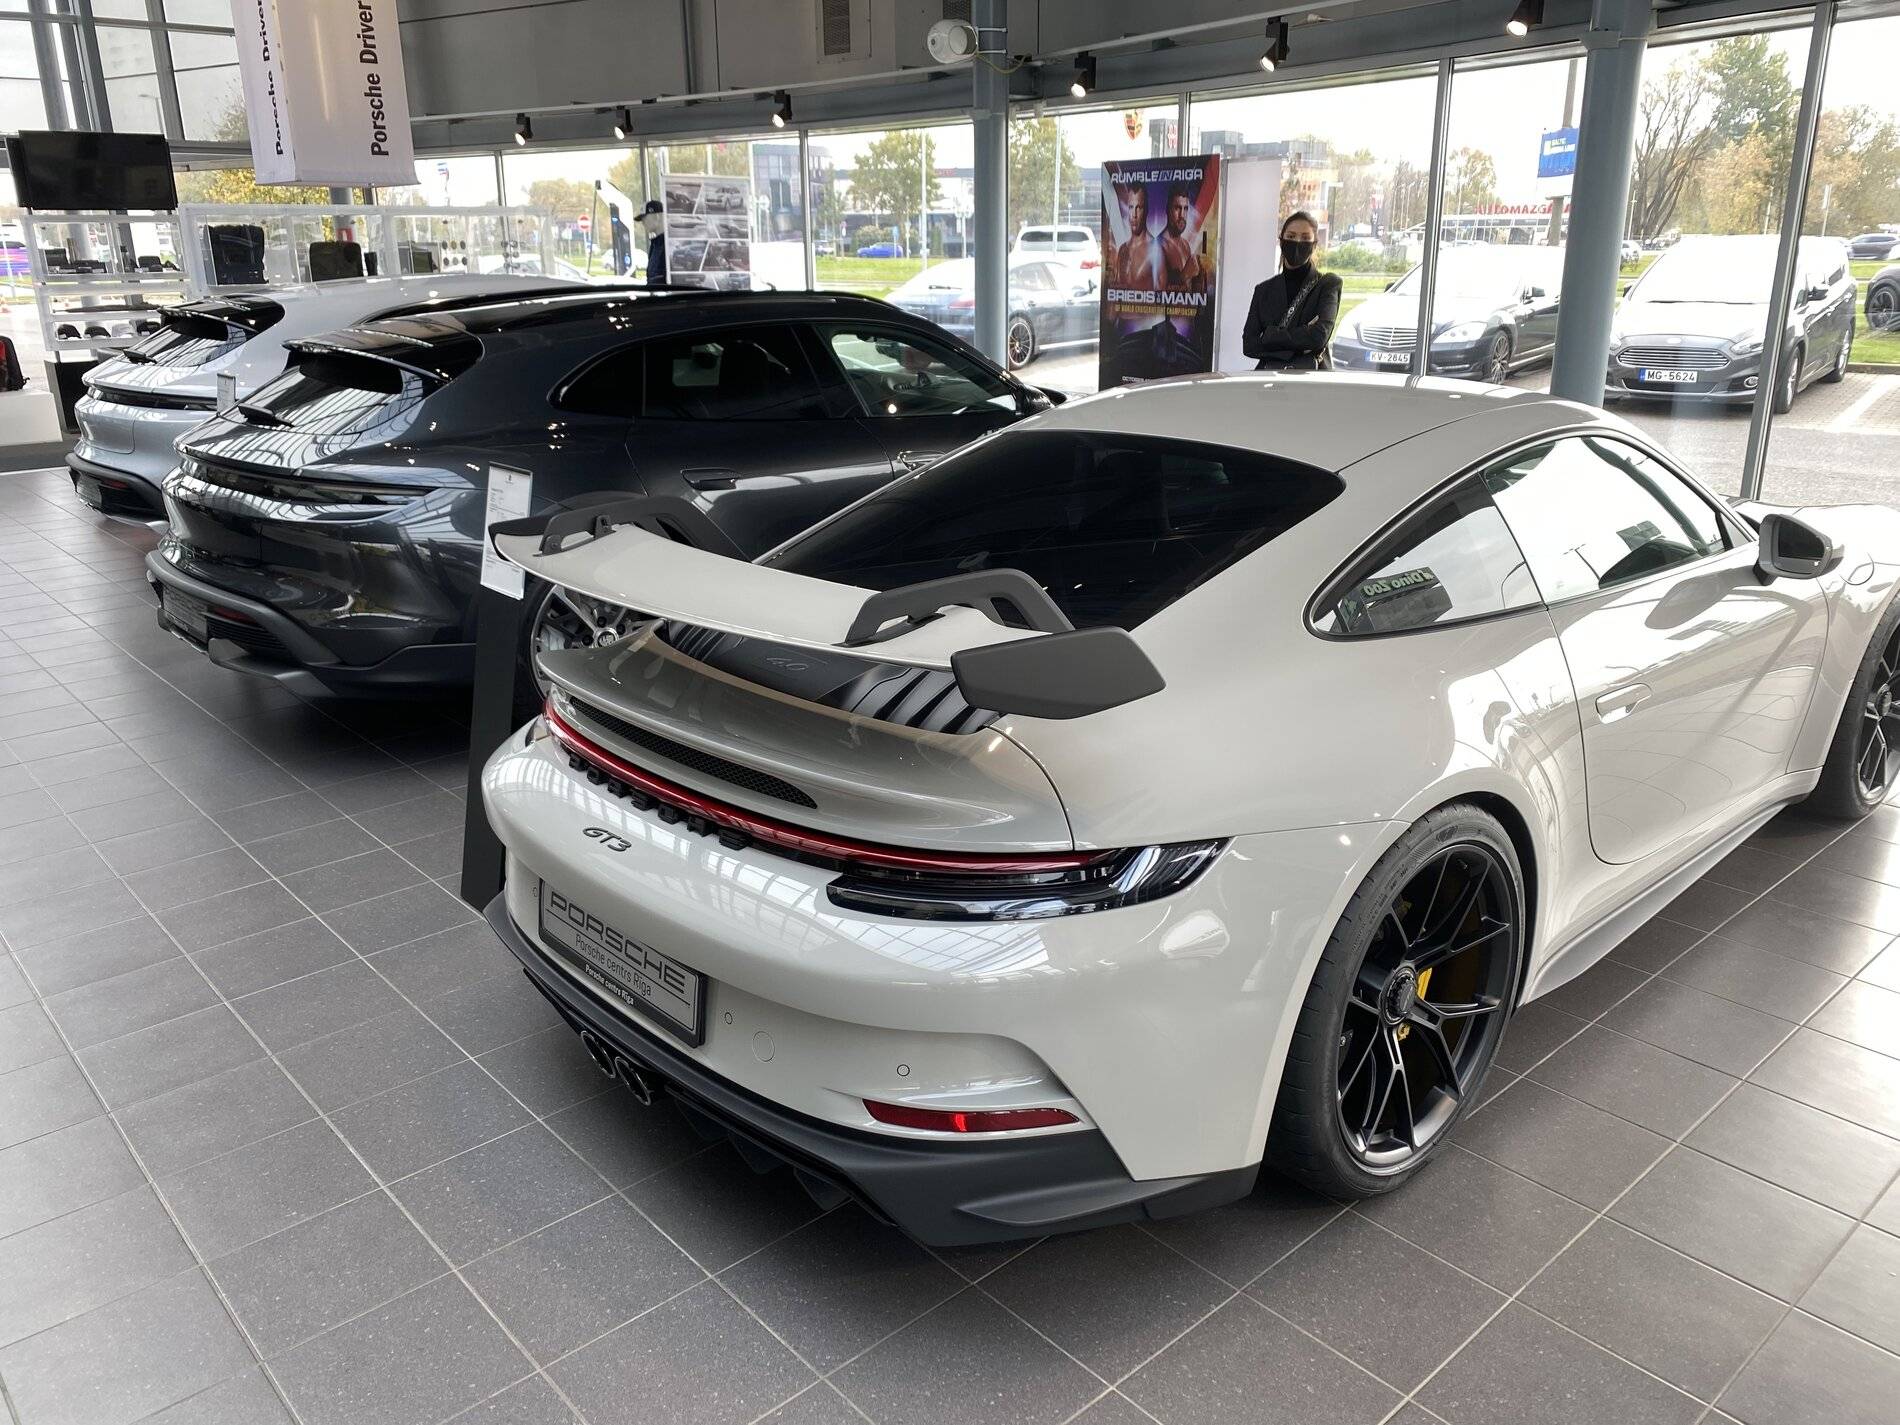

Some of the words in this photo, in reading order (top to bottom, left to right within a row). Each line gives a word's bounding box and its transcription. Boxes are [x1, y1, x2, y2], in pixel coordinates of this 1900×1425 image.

[268, 70, 284, 155] Porsche
[363, 73, 390, 156] Porsche
[1110, 170, 1159, 183] RUMBLE
[1173, 168, 1203, 180] RIGA
[1107, 288, 1156, 303] BRIEDIS
[1161, 291, 1208, 306] MANN
[1647, 370, 1695, 381] MG-5624
[582, 826, 632, 852] GT3
[551, 890, 686, 994] PORSCHE
[575, 933, 605, 965] Porsche
[606, 957, 632, 983] centrs
[585, 964, 605, 984] Porsche
[604, 980, 621, 996] centrs
